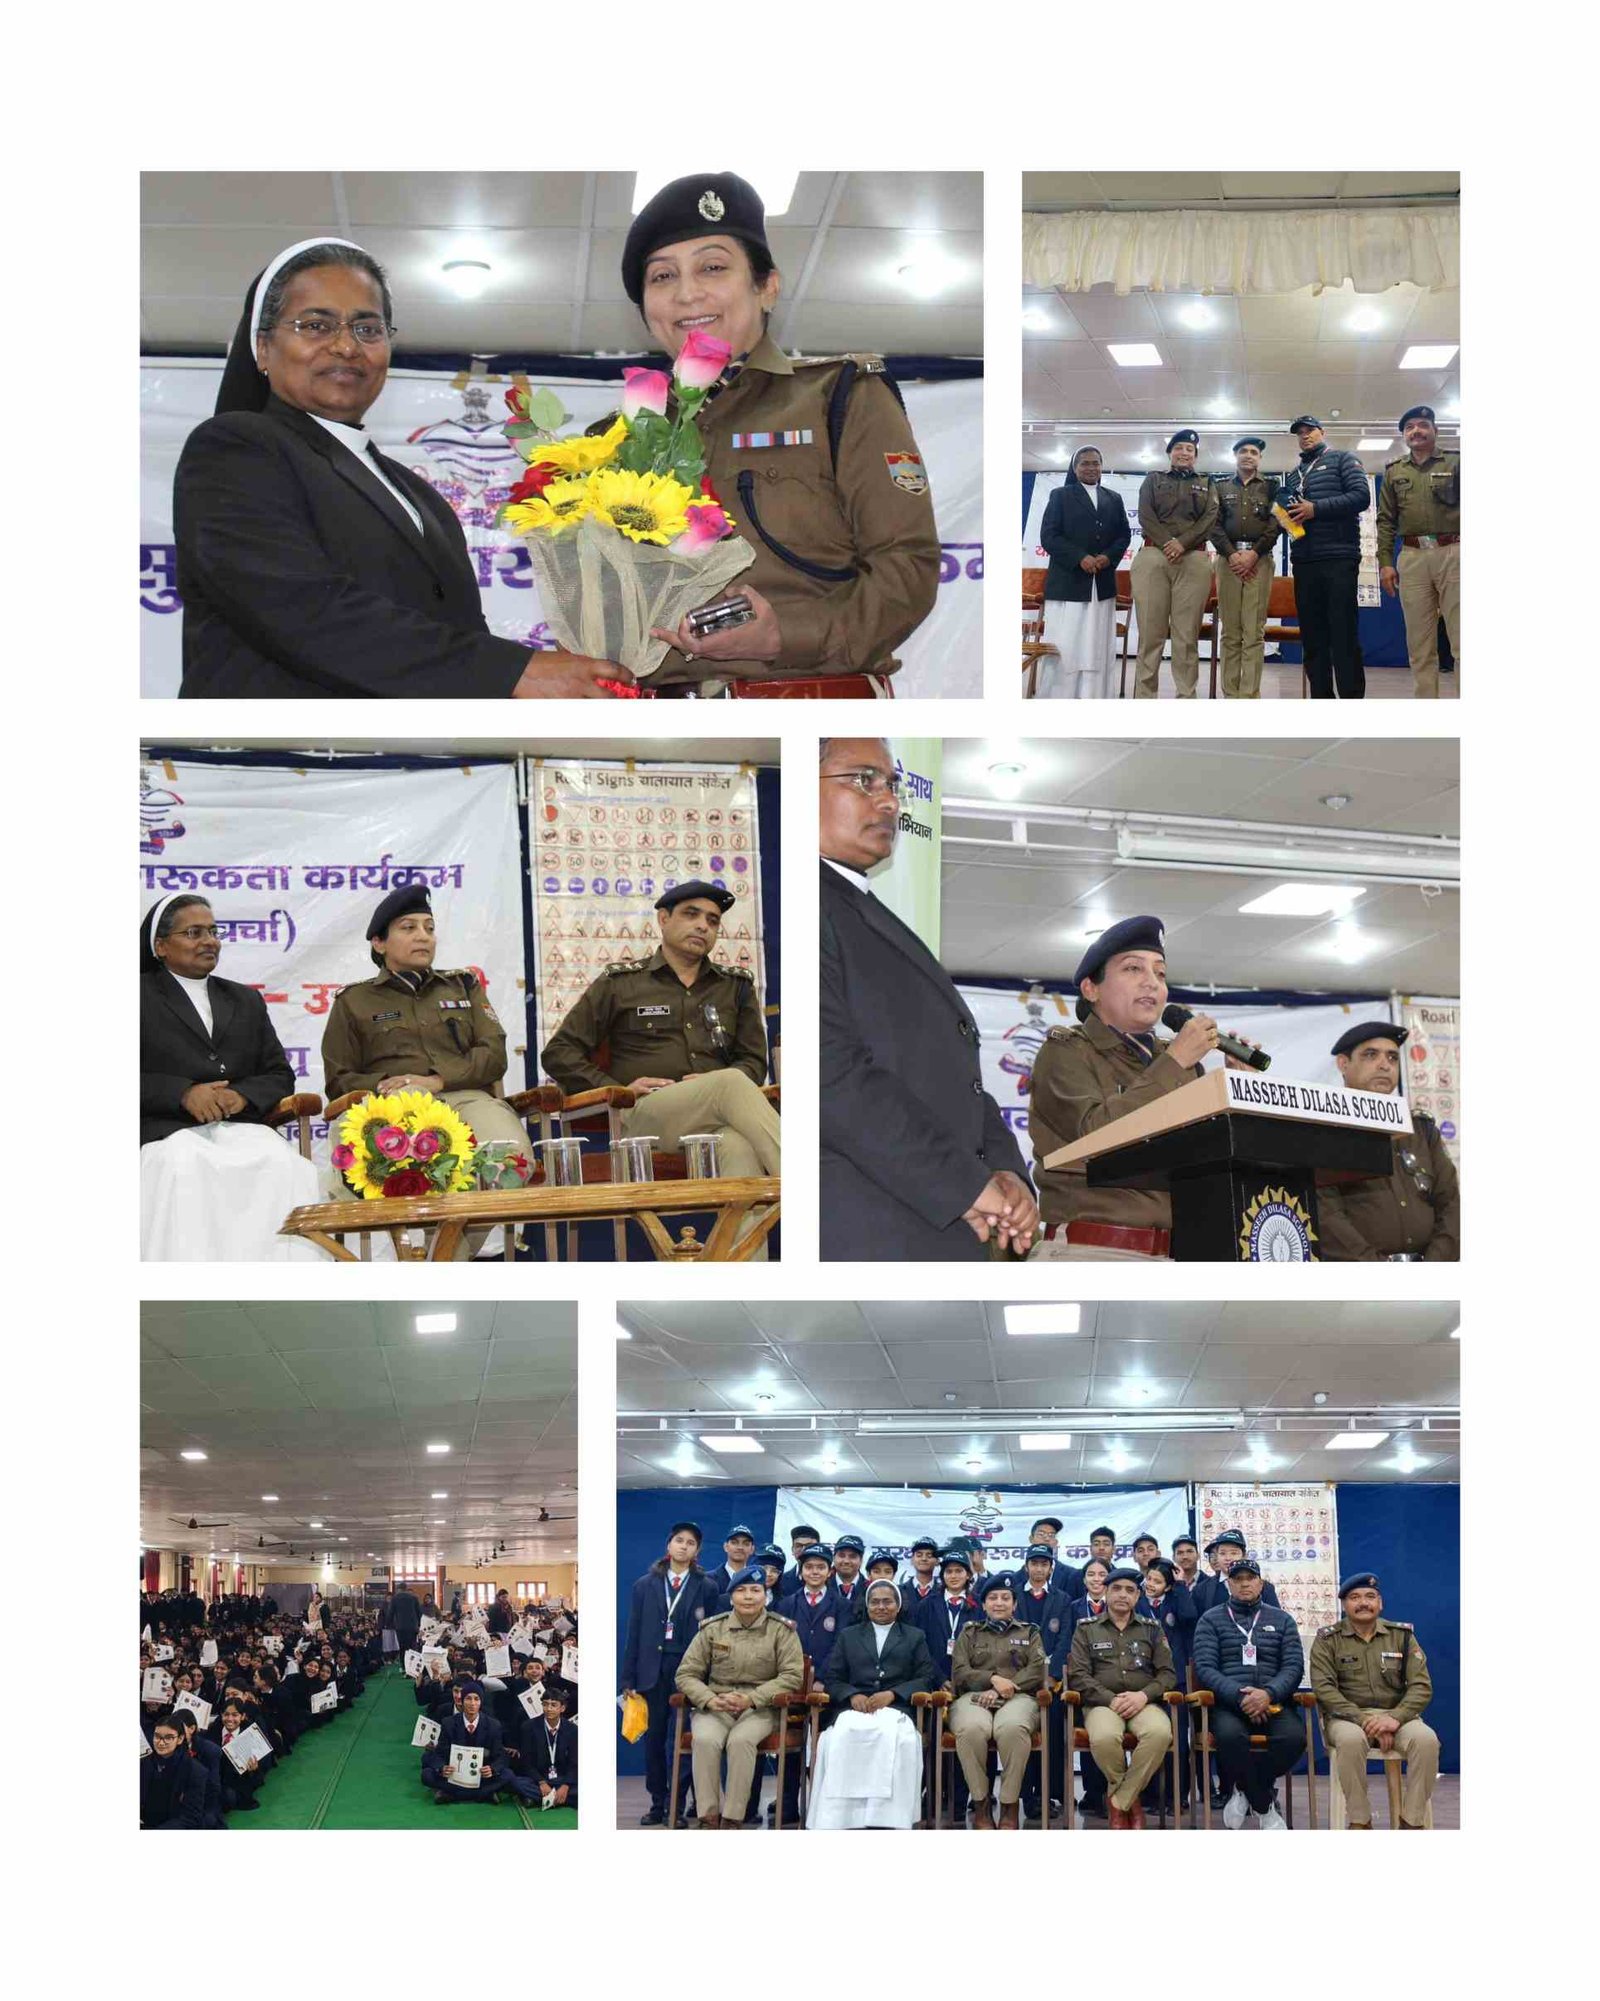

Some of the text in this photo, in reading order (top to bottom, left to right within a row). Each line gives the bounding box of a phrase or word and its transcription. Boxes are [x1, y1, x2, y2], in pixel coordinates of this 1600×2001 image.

[597, 774, 634, 787] Signs
[639, 775, 692, 788] यातायात
[1421, 1009, 1456, 1024] Road
[1230, 1077, 1403, 1124] MASSEEH DILASA SCHOOL
[1267, 1203, 1291, 1218] DILASA
